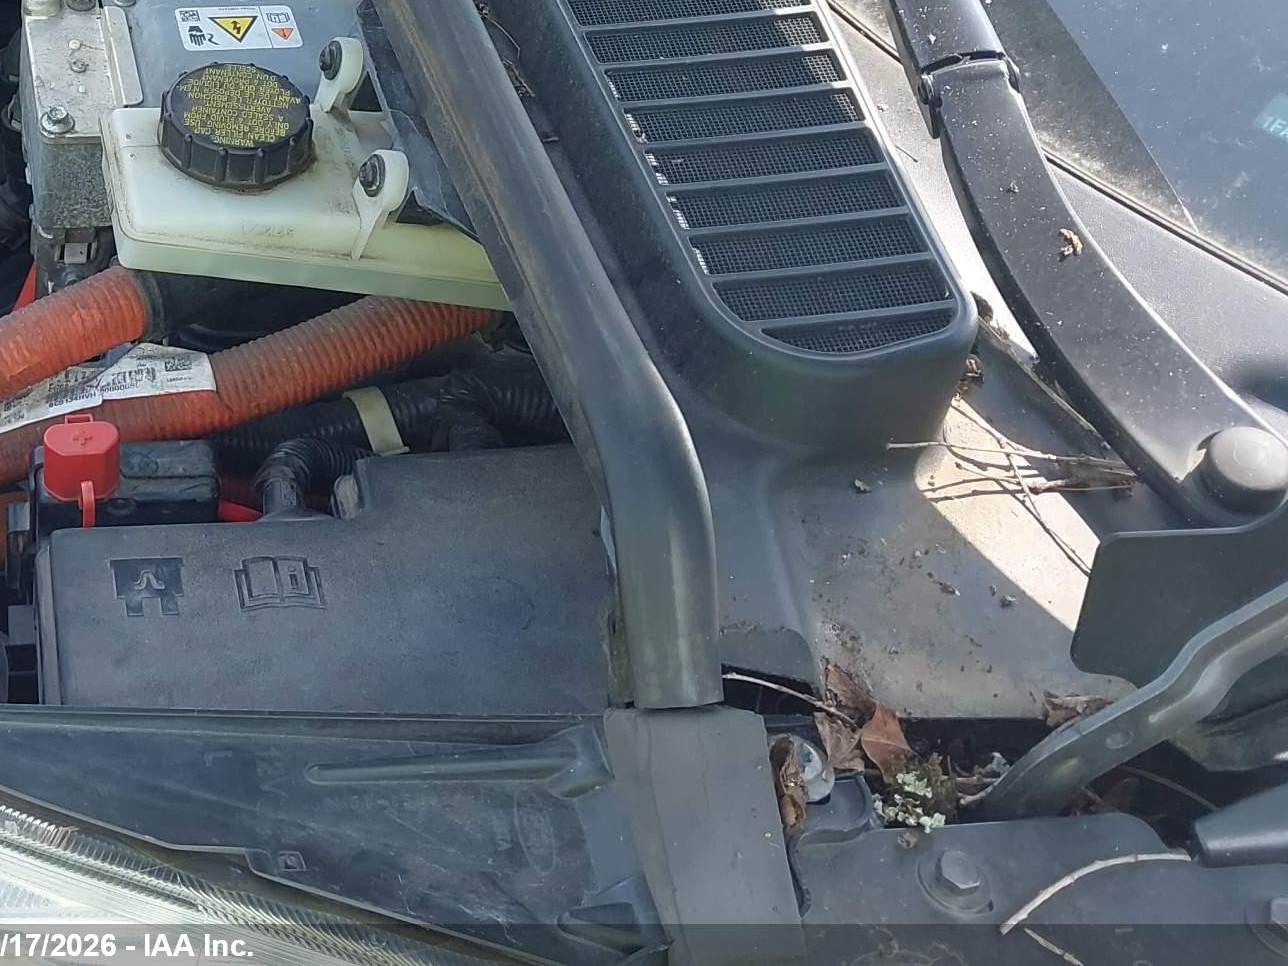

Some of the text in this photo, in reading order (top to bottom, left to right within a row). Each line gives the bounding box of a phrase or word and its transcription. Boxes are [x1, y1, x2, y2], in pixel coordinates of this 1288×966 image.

[204, 68, 252, 77] CONTENANT
[186, 79, 220, 88] LIQUIDE
[201, 74, 249, 84] PROVENANT
[259, 86, 290, 94] PLOYER
[187, 92, 228, 101] BOUCHON
[245, 97, 289, 108] NETTOYER
[190, 106, 237, 115] CONTAINER
[210, 114, 234, 122] FLUID
[240, 111, 273, 120] SEALED
[182, 119, 201, 127] USE
[265, 120, 289, 128] ONLY
[214, 130, 244, 138] FILLER
[253, 126, 286, 135] BEFORE
[246, 133, 275, 141] CLEAN
